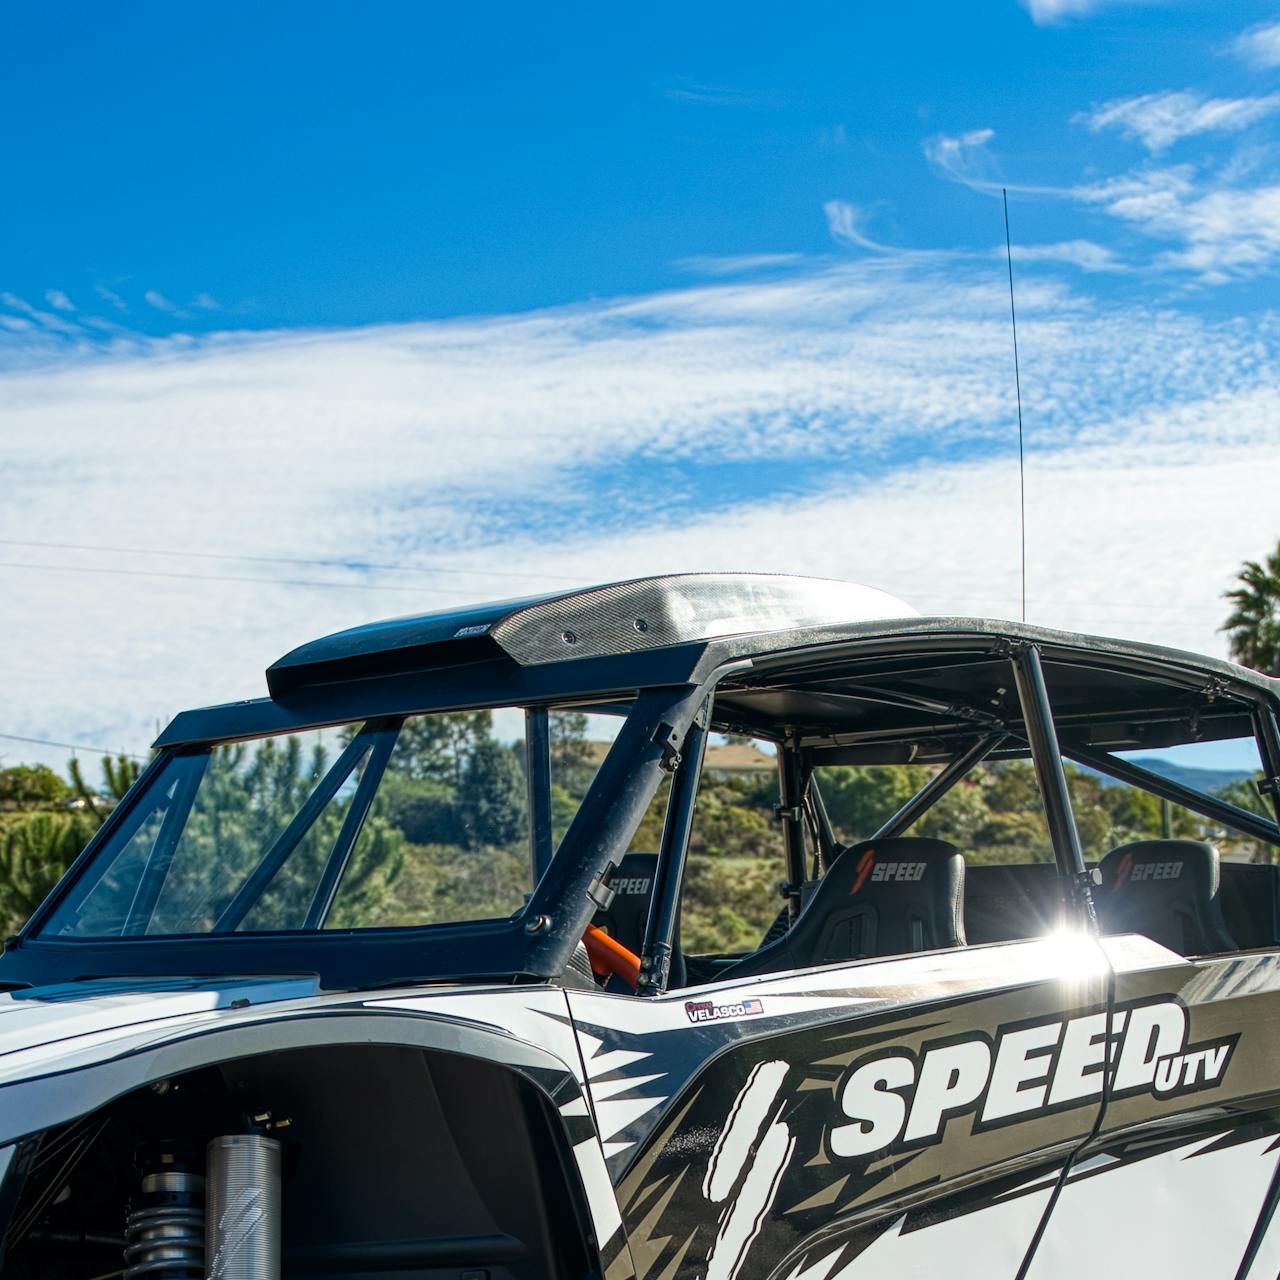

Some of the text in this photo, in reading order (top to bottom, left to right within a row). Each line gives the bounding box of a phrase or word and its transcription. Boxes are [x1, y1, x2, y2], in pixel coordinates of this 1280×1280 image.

[871, 862, 927, 881] SPEED
[1130, 861, 1184, 881] SPEED
[608, 878, 651, 895] SPEED
[688, 1004, 746, 1022] VELASCO
[830, 1003, 1231, 1158] SPEED UTV
